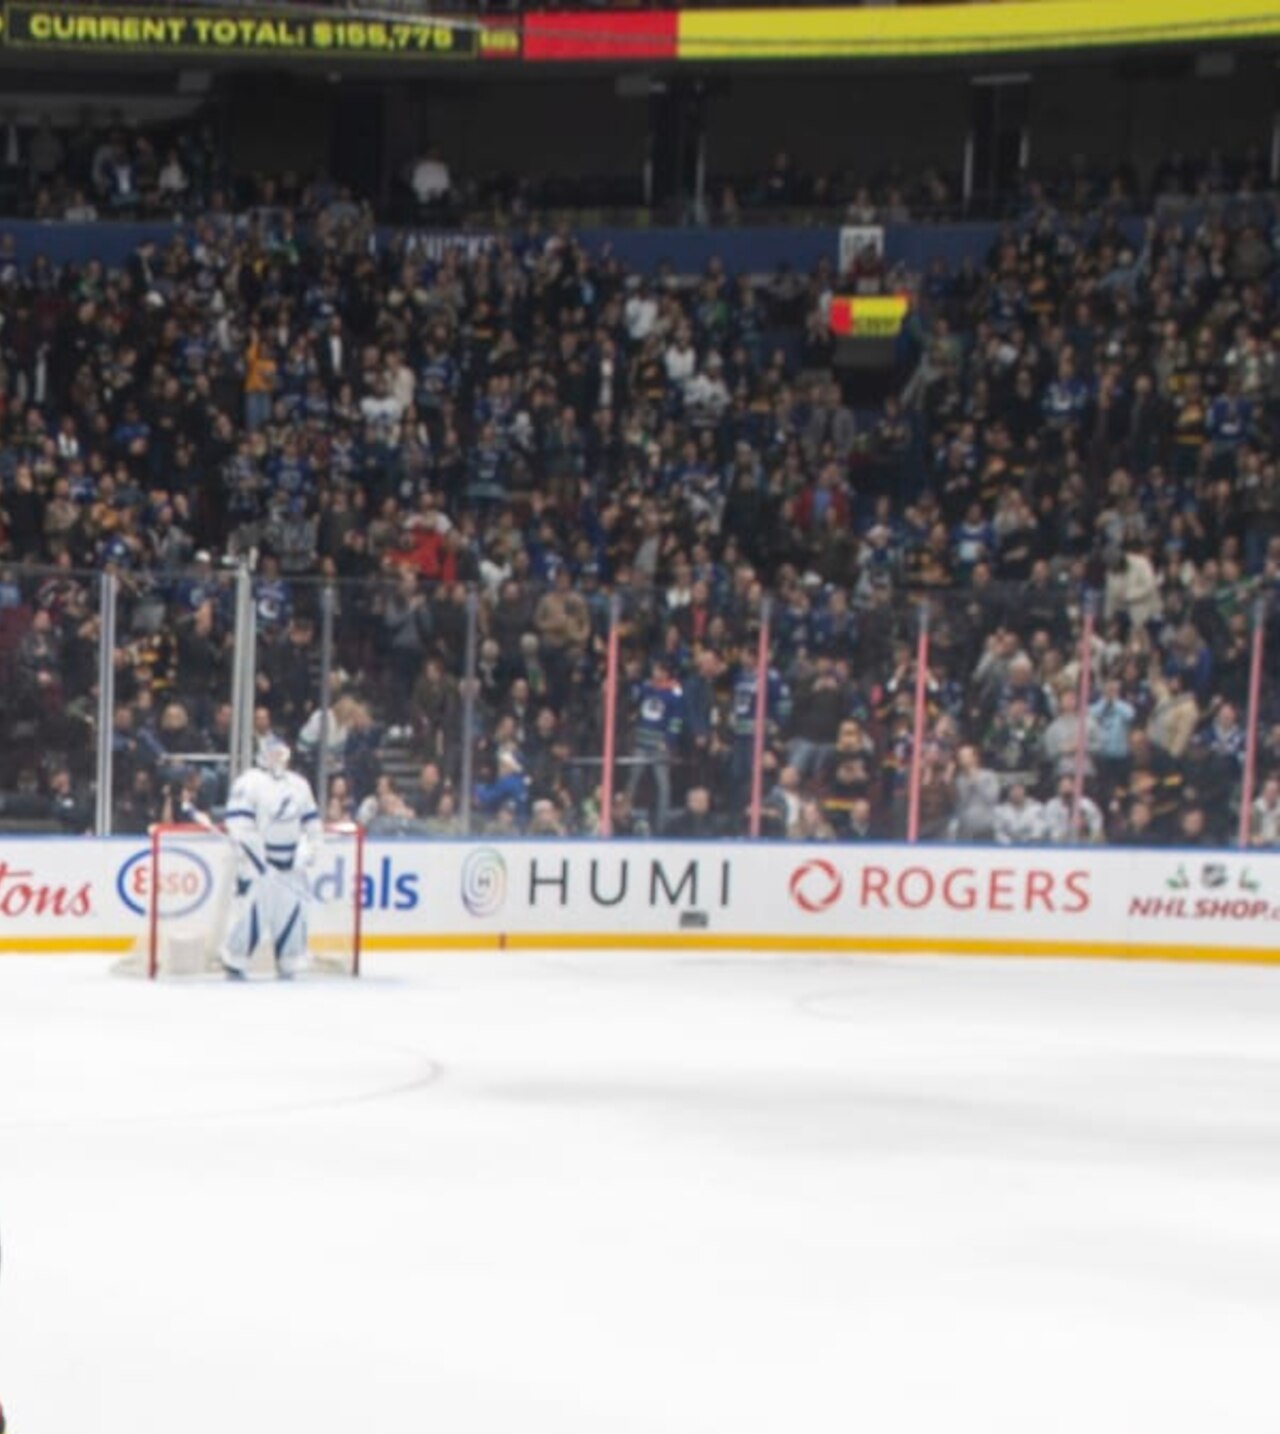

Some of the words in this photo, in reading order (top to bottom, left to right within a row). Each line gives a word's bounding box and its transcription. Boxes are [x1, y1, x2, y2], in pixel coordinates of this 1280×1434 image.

[28, 13, 188, 43] CURRENT
[193, 17, 306, 47] TOTAL:
[312, 856, 421, 911] dals
[527, 856, 731, 908] HUMI
[858, 866, 1093, 915] ROGERS
